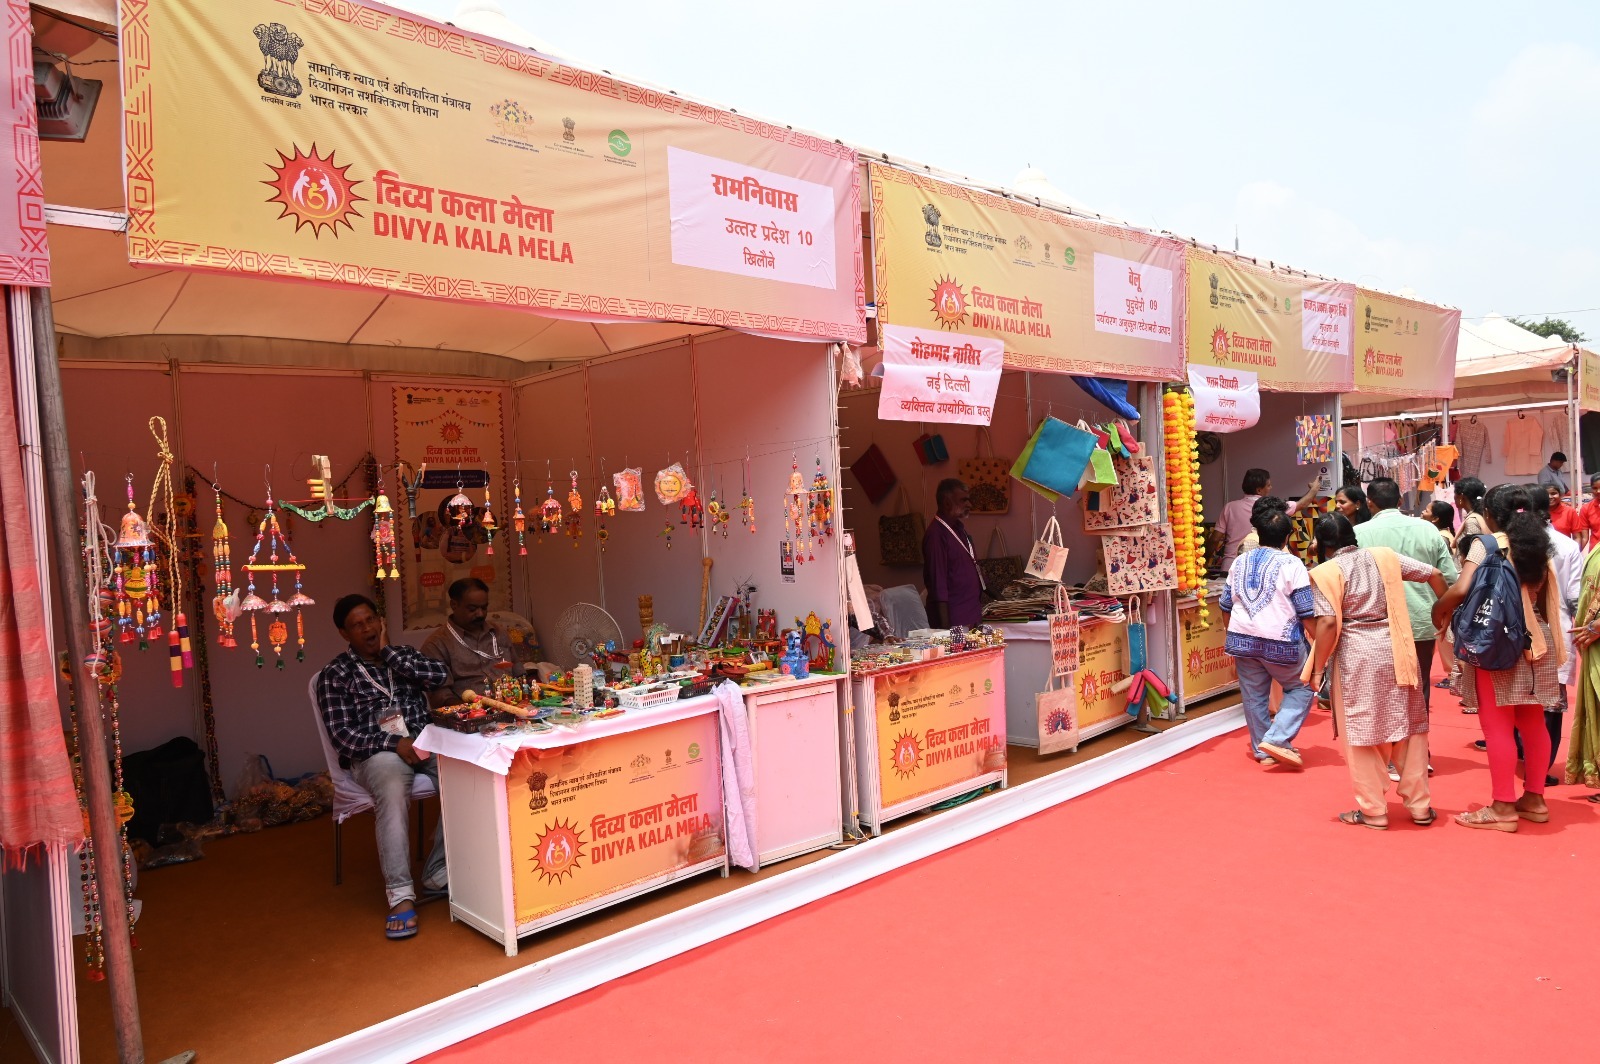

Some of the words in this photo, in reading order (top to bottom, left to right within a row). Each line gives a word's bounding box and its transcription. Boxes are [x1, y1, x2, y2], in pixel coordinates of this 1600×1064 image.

[307, 61, 350, 81] सामाजिक
[353, 72, 375, 87] न्याय
[377, 77, 390, 92] एवं
[393, 82, 439, 103] अधिकारिता
[441, 93, 472, 111] मंत्रालय
[308, 74, 354, 98] दिव्यांगजन
[357, 90, 409, 111] सशक्तिकरण
[412, 101, 440, 118] विभाग
[309, 94, 335, 109] भारत
[338, 101, 368, 116] सरकार
[373, 169, 434, 214] दिव्य
[438, 189, 497, 224] कला
[501, 195, 554, 233] मेला
[711, 173, 798, 213] रामनिवास
[374, 212, 448, 247] DIVYA
[455, 225, 513, 255] KALA
[518, 235, 574, 264] MELA
[725, 218, 758, 239] उत्तर
[761, 221, 790, 245] प्रदेश
[798, 230, 813, 246] 10
[743, 246, 775, 269] खिलौने
[1128, 267, 1142, 293] वेलू
[971, 286, 995, 311] दिव्य
[996, 296, 1019, 315] कला
[1020, 296, 1042, 319] मेला
[1126, 296, 1145, 315] पुदुचेरी
[1150, 300, 1157, 310] 09
[973, 312, 1001, 331] DIVYA
[1004, 318, 1026, 335] KALA
[1028, 322, 1051, 338] MELA
[911, 336, 950, 362] मोहम्मद
[953, 344, 981, 366] नासिर
[1232, 332, 1244, 349] दिव्य
[1246, 338, 1258, 351] कला
[1259, 336, 1272, 353] मेला
[1232, 351, 1247, 364] DIVYA
[1249, 353, 1262, 365] KALA
[1262, 355, 1276, 367] MELA
[926, 372, 940, 393] नई
[944, 373, 970, 392] दिल्ली
[937, 400, 974, 415] उपयोगिता
[977, 406, 990, 421] वस्तु
[426, 445, 442, 456] दिव्य
[462, 446, 478, 455] मेला
[925, 728, 947, 749] दिव्य
[948, 723, 969, 743] कला
[970, 717, 990, 736] मेला
[926, 748, 952, 767] DIVYA
[954, 741, 974, 759] KALA
[976, 735, 999, 752] MELA
[590, 813, 625, 842] दिव्य
[627, 802, 663, 830] कला
[664, 793, 698, 818] मेला
[591, 840, 636, 865] DIVYA
[638, 827, 673, 850] KALA
[676, 812, 711, 839] MELA
